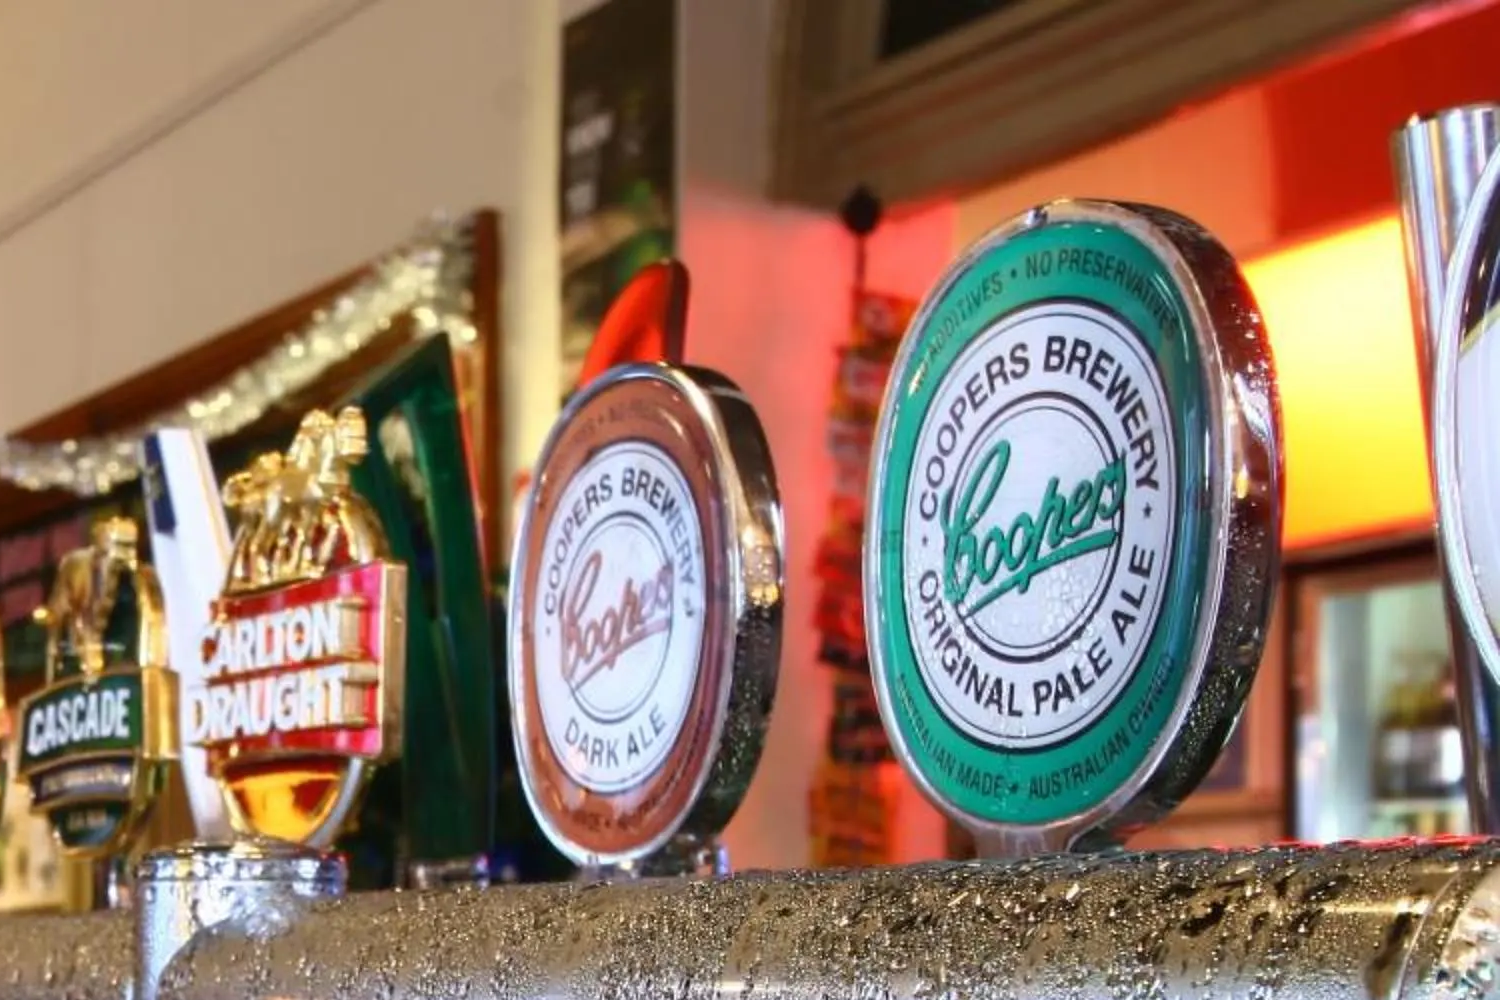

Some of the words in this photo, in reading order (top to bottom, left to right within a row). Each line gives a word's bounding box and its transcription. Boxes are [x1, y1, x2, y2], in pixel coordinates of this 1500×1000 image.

[1025, 250, 1051, 280] NO
[1057, 247, 1179, 338] PRESERVATIVES
[919, 341, 1031, 521] COOPERS
[1043, 335, 1160, 492] BREWERY
[544, 473, 613, 615] COOPERS
[620, 467, 695, 587] BREWERY
[199, 598, 342, 676] CARLTON
[918, 570, 1024, 717] ORIGINAL
[1033, 637, 1113, 716] PALE
[1110, 544, 1156, 645] ALE
[27, 688, 131, 756] CASCADE
[184, 665, 350, 742] DRAUGHT
[564, 716, 620, 769] DARK
[626, 703, 668, 764] ALE
[956, 763, 1003, 796] MADE
[1029, 731, 1130, 799] AUSTRALIAN
